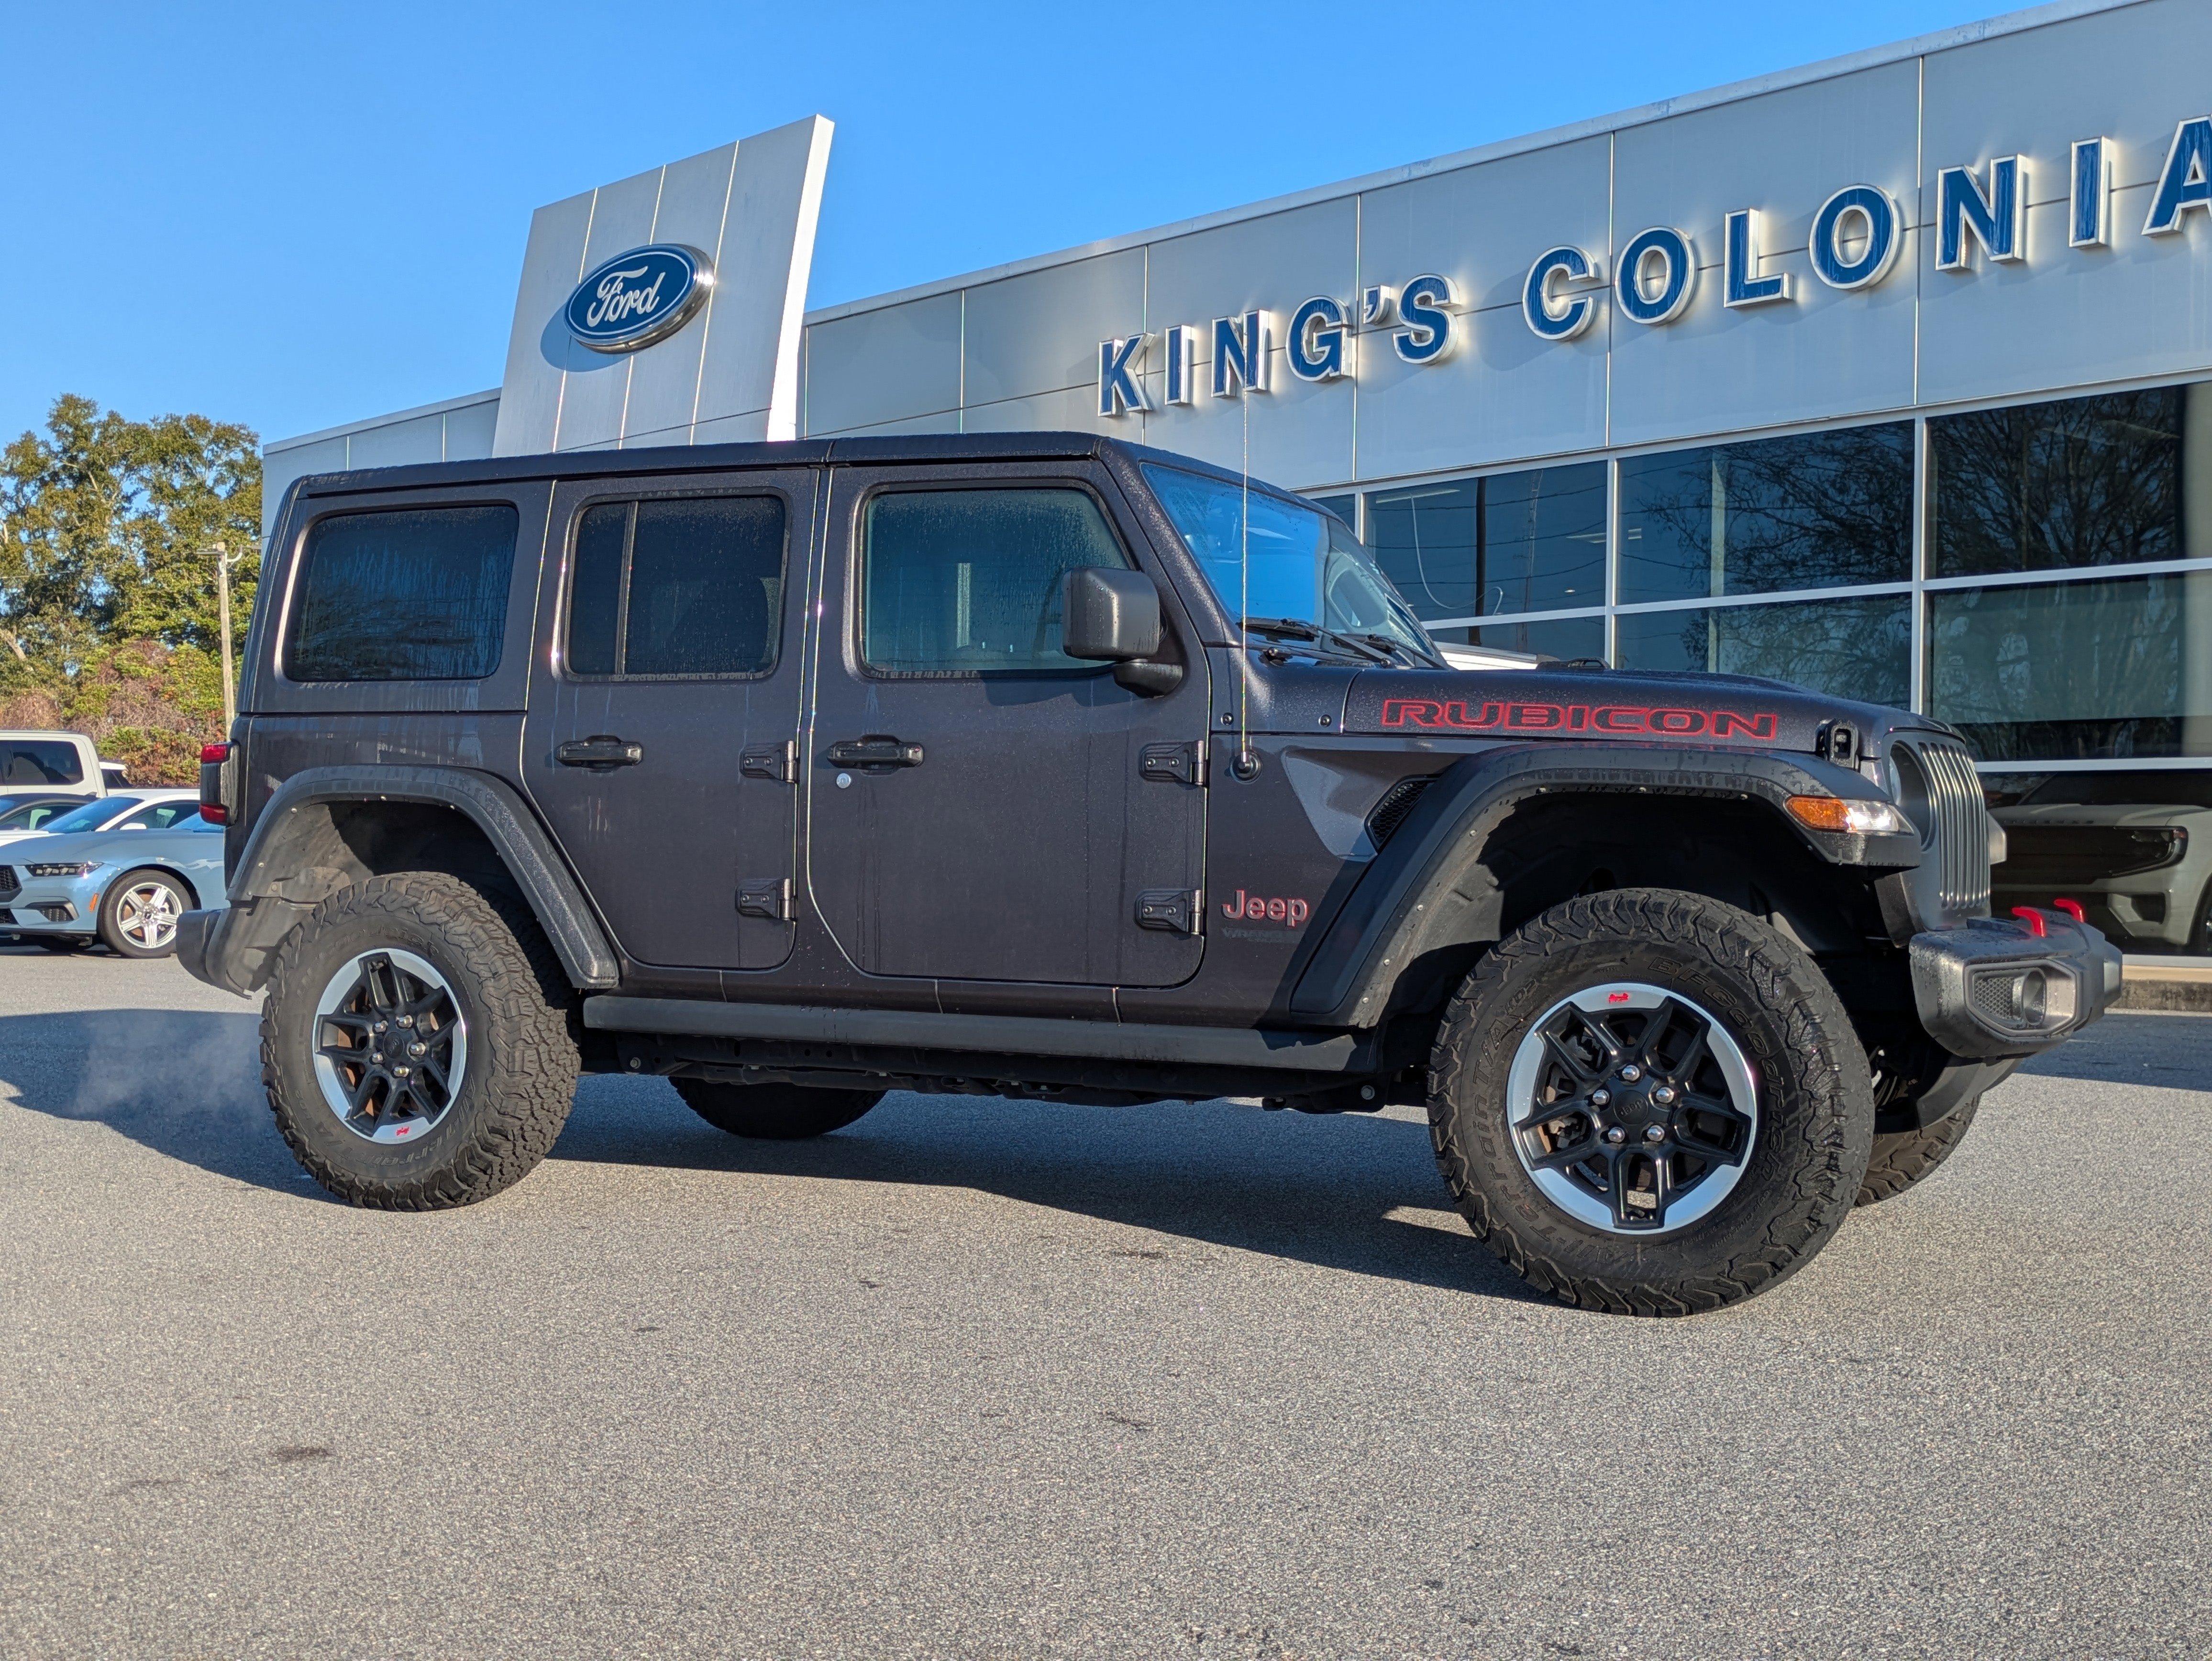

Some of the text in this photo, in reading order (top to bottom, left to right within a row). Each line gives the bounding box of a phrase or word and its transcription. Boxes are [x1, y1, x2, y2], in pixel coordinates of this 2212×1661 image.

[587, 266, 666, 327] Ford
[1098, 115, 2212, 418] KING'S COLONIA
[1381, 699, 1778, 739] RUBICON
[1221, 889, 1308, 927] Jeep
[1648, 955, 1785, 1182] BFGoodrich
[1618, 1099, 1643, 1117] Jeep
[1472, 1094, 1621, 1264] All-Terrain
